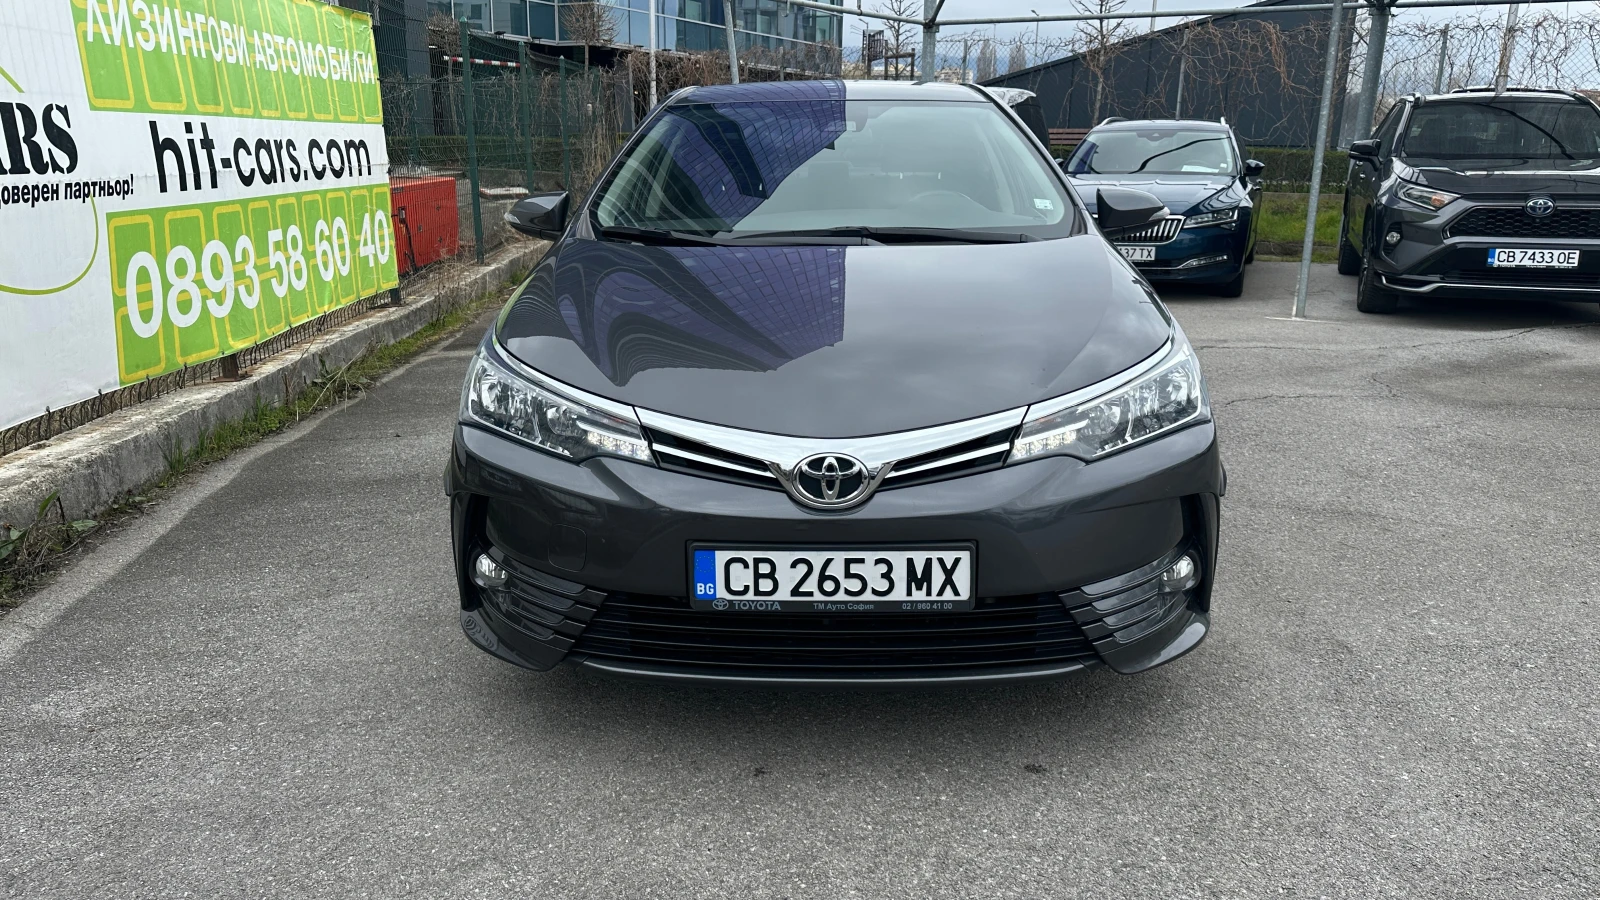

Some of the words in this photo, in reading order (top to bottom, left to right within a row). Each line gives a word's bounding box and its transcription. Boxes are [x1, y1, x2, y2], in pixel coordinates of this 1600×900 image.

[86, 0, 250, 67] ЛИЗИНГОВИ
[253, 29, 375, 85] АВТОМОБИЛИ
[0, 101, 79, 175] RS
[148, 120, 372, 193] hit-cars.com
[0, 183, 60, 209] оверен
[64, 173, 134, 204] партньор!
[1138, 247, 1153, 259] TX
[1497, 250, 1516, 263] CB
[1518, 250, 1555, 264] 7433
[125, 234, 260, 339] 0893
[267, 224, 308, 298] 58
[314, 216, 351, 282] 60
[358, 209, 391, 268] 40
[696, 583, 715, 595] BG
[723, 556, 780, 597] CB
[789, 556, 896, 598] 2653
[905, 556, 963, 597] MX
[732, 600, 782, 611] TOYOTA
[847, 602, 875, 611] София
[902, 602, 911, 610] 02
[917, 602, 931, 610] 960
[932, 602, 942, 610] 41
[943, 602, 953, 610] 00
